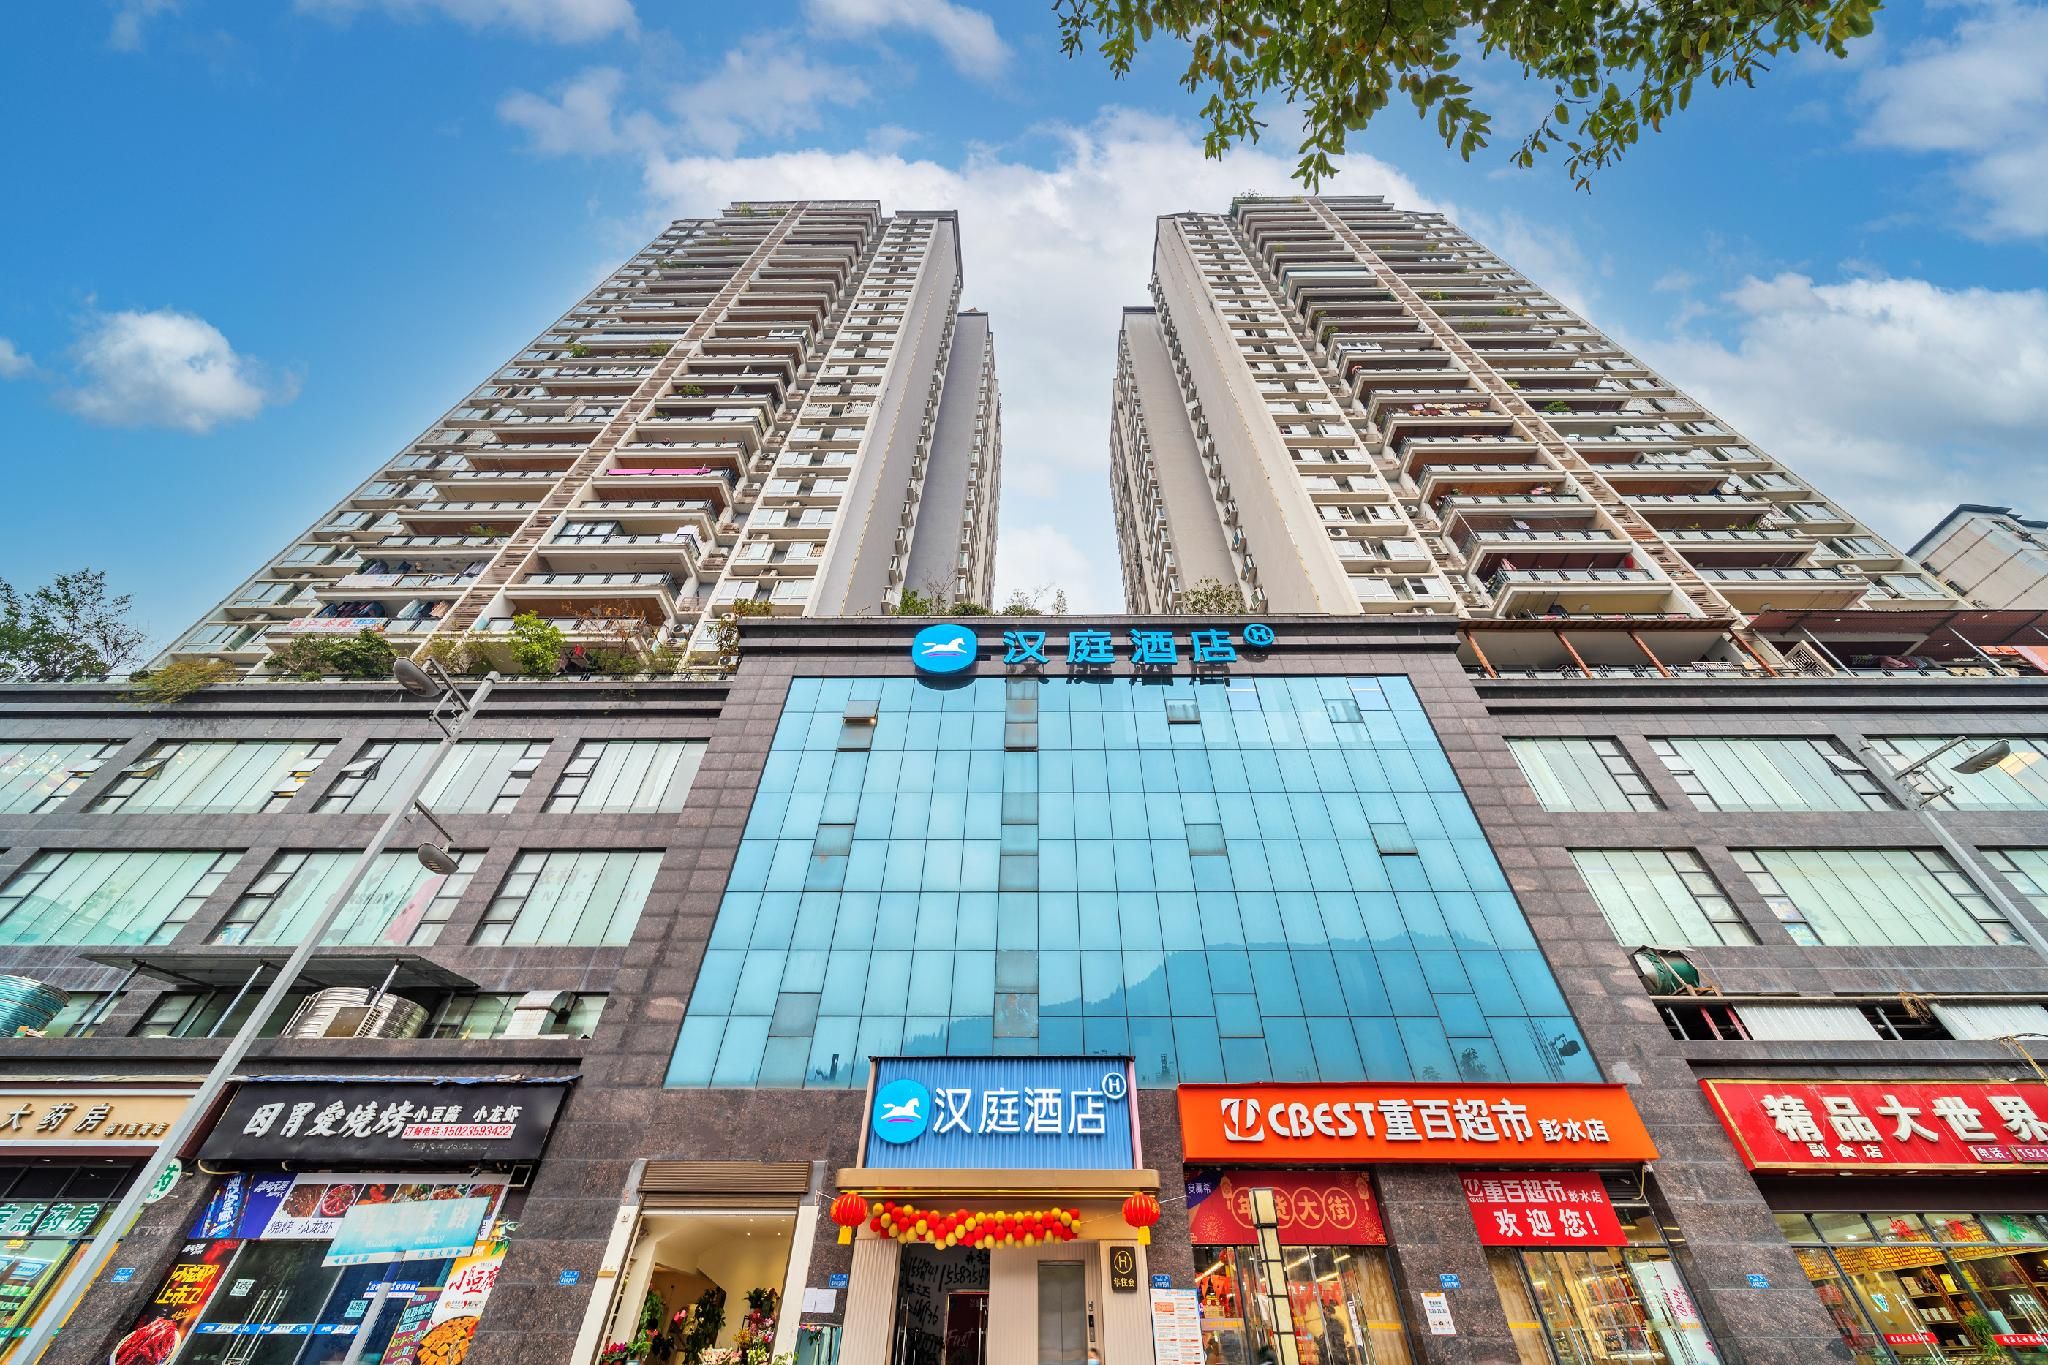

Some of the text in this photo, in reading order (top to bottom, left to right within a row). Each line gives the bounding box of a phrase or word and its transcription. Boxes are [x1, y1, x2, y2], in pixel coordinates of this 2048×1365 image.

[1003, 628, 1238, 665] 汉庭酒店
[0, 1103, 115, 1133] 大药房
[473, 1105, 523, 1123] 小龙虾
[932, 1086, 1106, 1136] 汉庭酒店
[1268, 1098, 1611, 1143] CBEST 重百超市 彭水店
[1761, 1094, 2048, 1143] 精品大世界
[1806, 1142, 1883, 1158] 副食店
[1482, 1179, 1568, 1204] 重百超市
[1568, 1189, 1603, 1204] 彭水店
